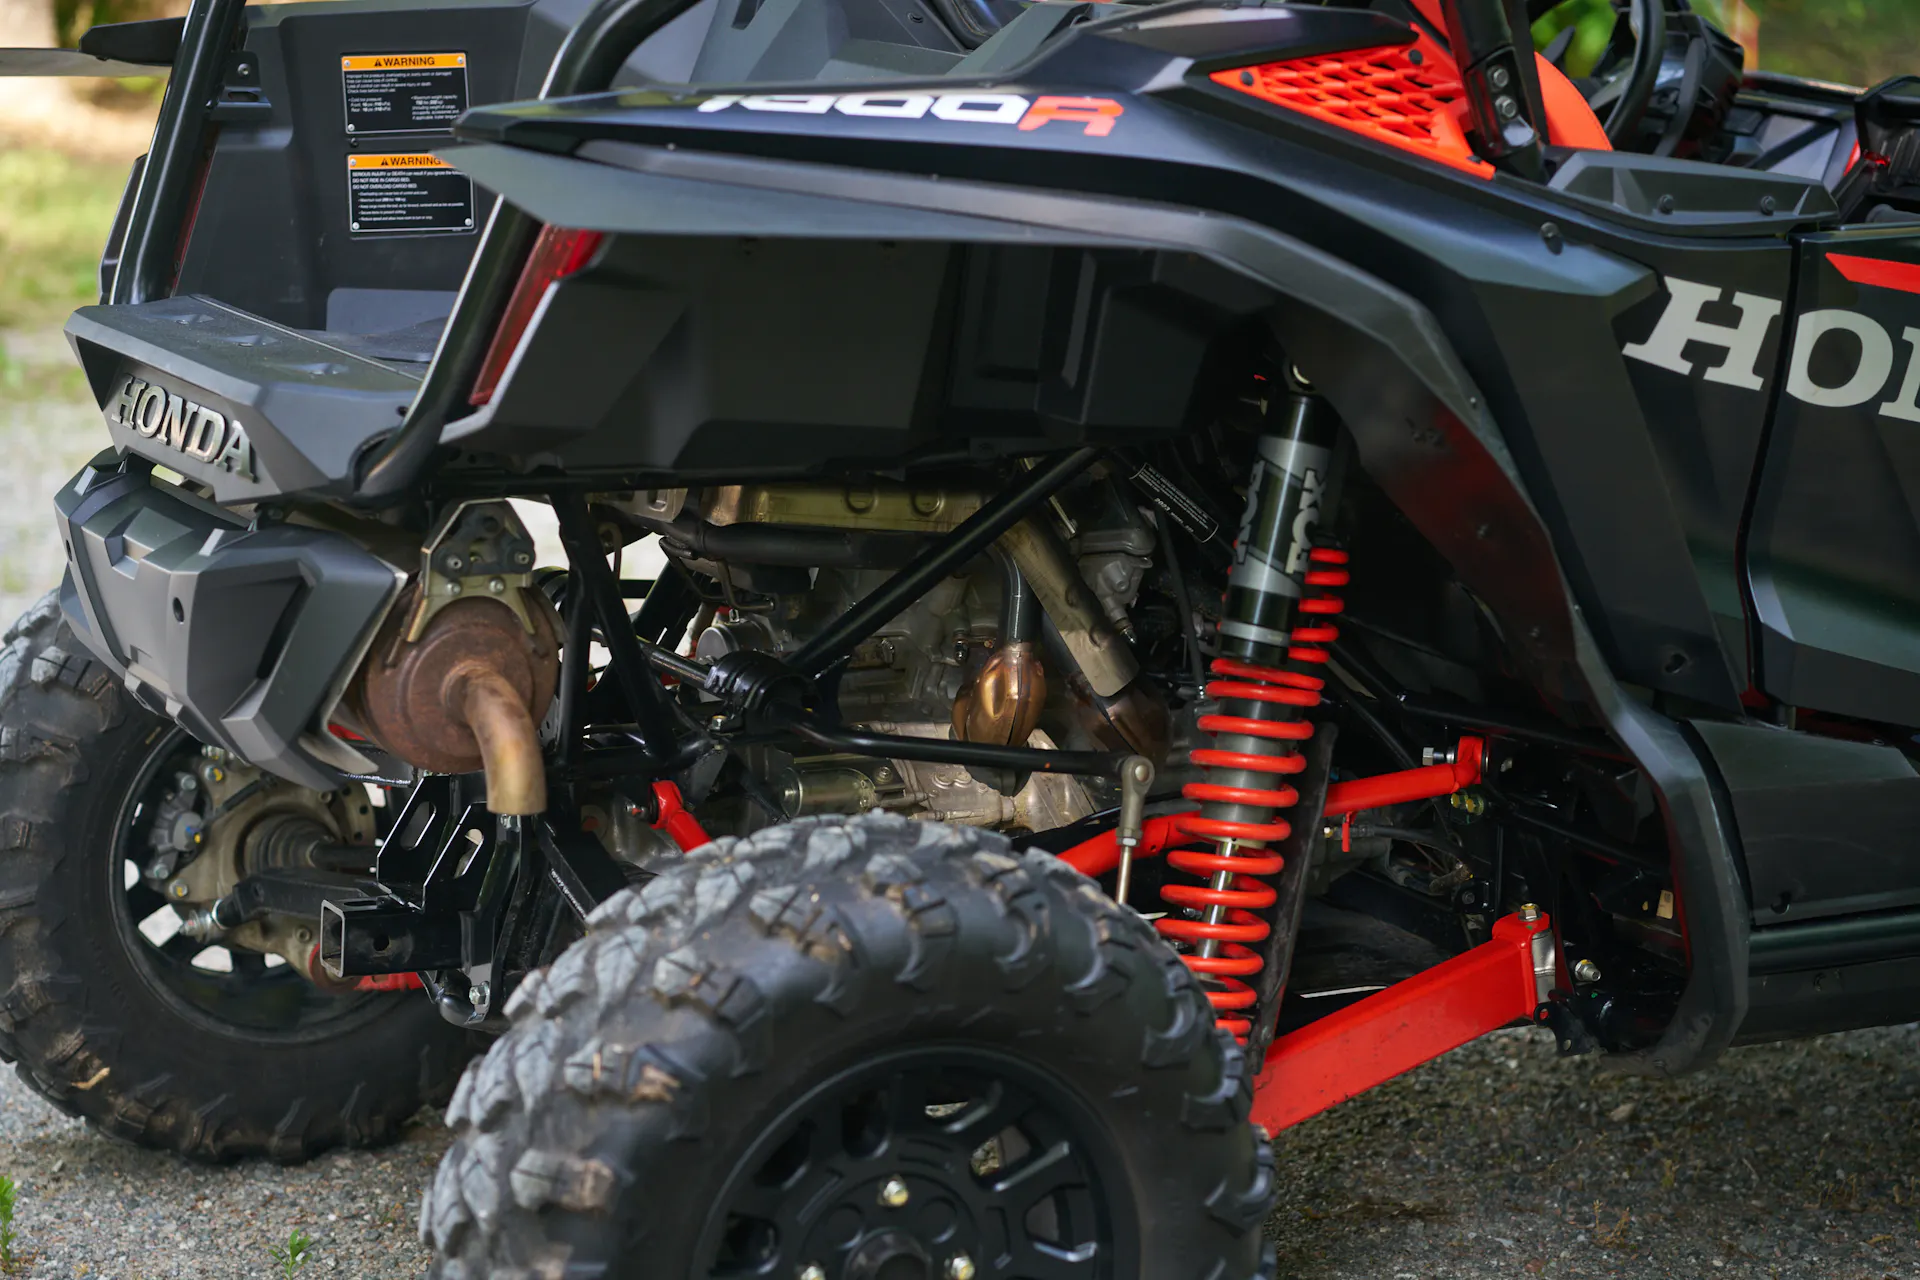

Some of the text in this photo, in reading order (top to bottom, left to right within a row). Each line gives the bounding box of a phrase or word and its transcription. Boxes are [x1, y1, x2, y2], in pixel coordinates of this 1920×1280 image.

[383, 56, 435, 67] WARNING
[391, 156, 441, 166] WARNING
[1622, 275, 1920, 423] HO
[111, 376, 257, 482] HONDA
